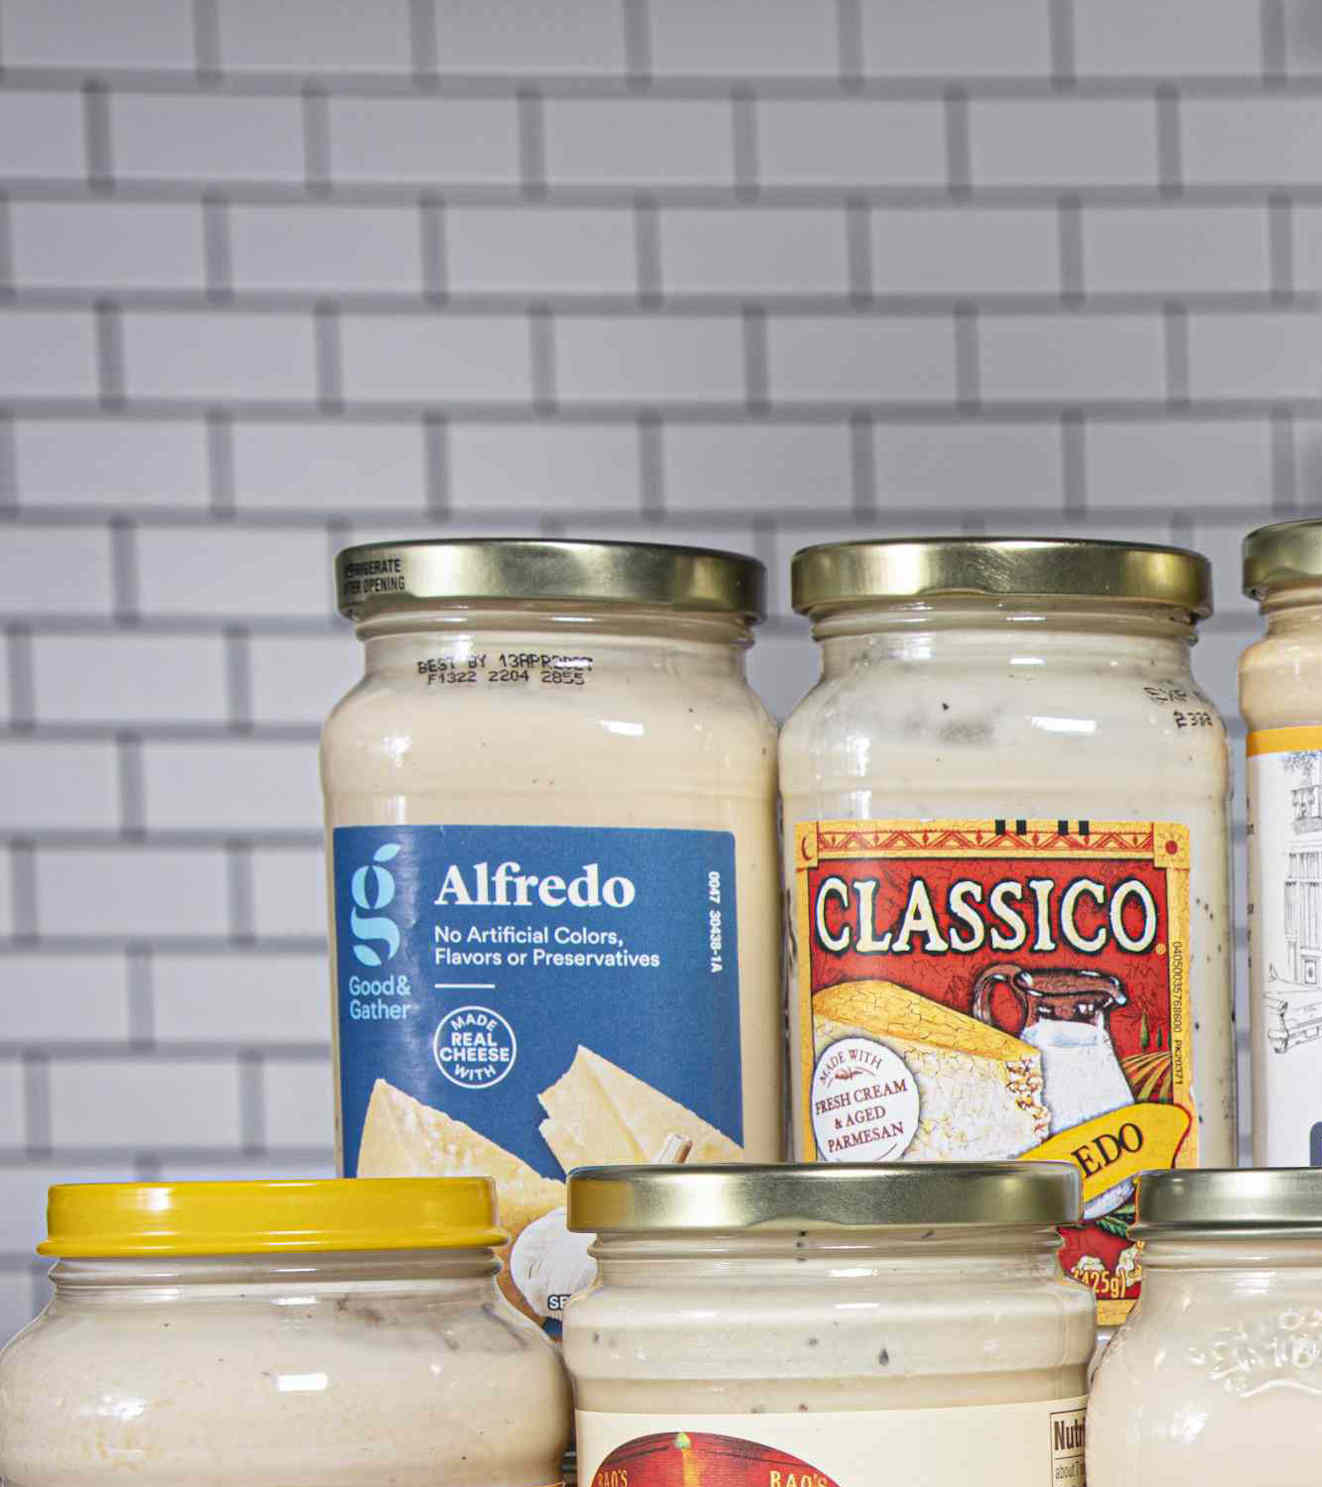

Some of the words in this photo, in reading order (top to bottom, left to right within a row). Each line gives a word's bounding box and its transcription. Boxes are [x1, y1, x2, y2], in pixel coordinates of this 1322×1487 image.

[434, 862, 635, 908] Alfredo
[816, 877, 1158, 952] CLASSICO
[435, 927, 461, 944] No
[467, 926, 548, 944] Artificial
[555, 927, 623, 947] Colors,
[435, 949, 501, 966] Flavors
[508, 952, 528, 966] or
[533, 950, 660, 967] Preservatives
[350, 1000, 408, 1020] Gather
[451, 1014, 497, 1031] MADE
[452, 1032, 497, 1046] REAL
[440, 1048, 509, 1061] CHEESE
[819, 1055, 846, 1080] MADE
[852, 1050, 882, 1070] WITH
[455, 1065, 496, 1080] WITH
[816, 1091, 850, 1114] FRESH
[854, 1080, 907, 1101] CREAM
[835, 1118, 843, 1129] &
[848, 1106, 885, 1124] AGED
[828, 1123, 904, 1152] PARMESAN
